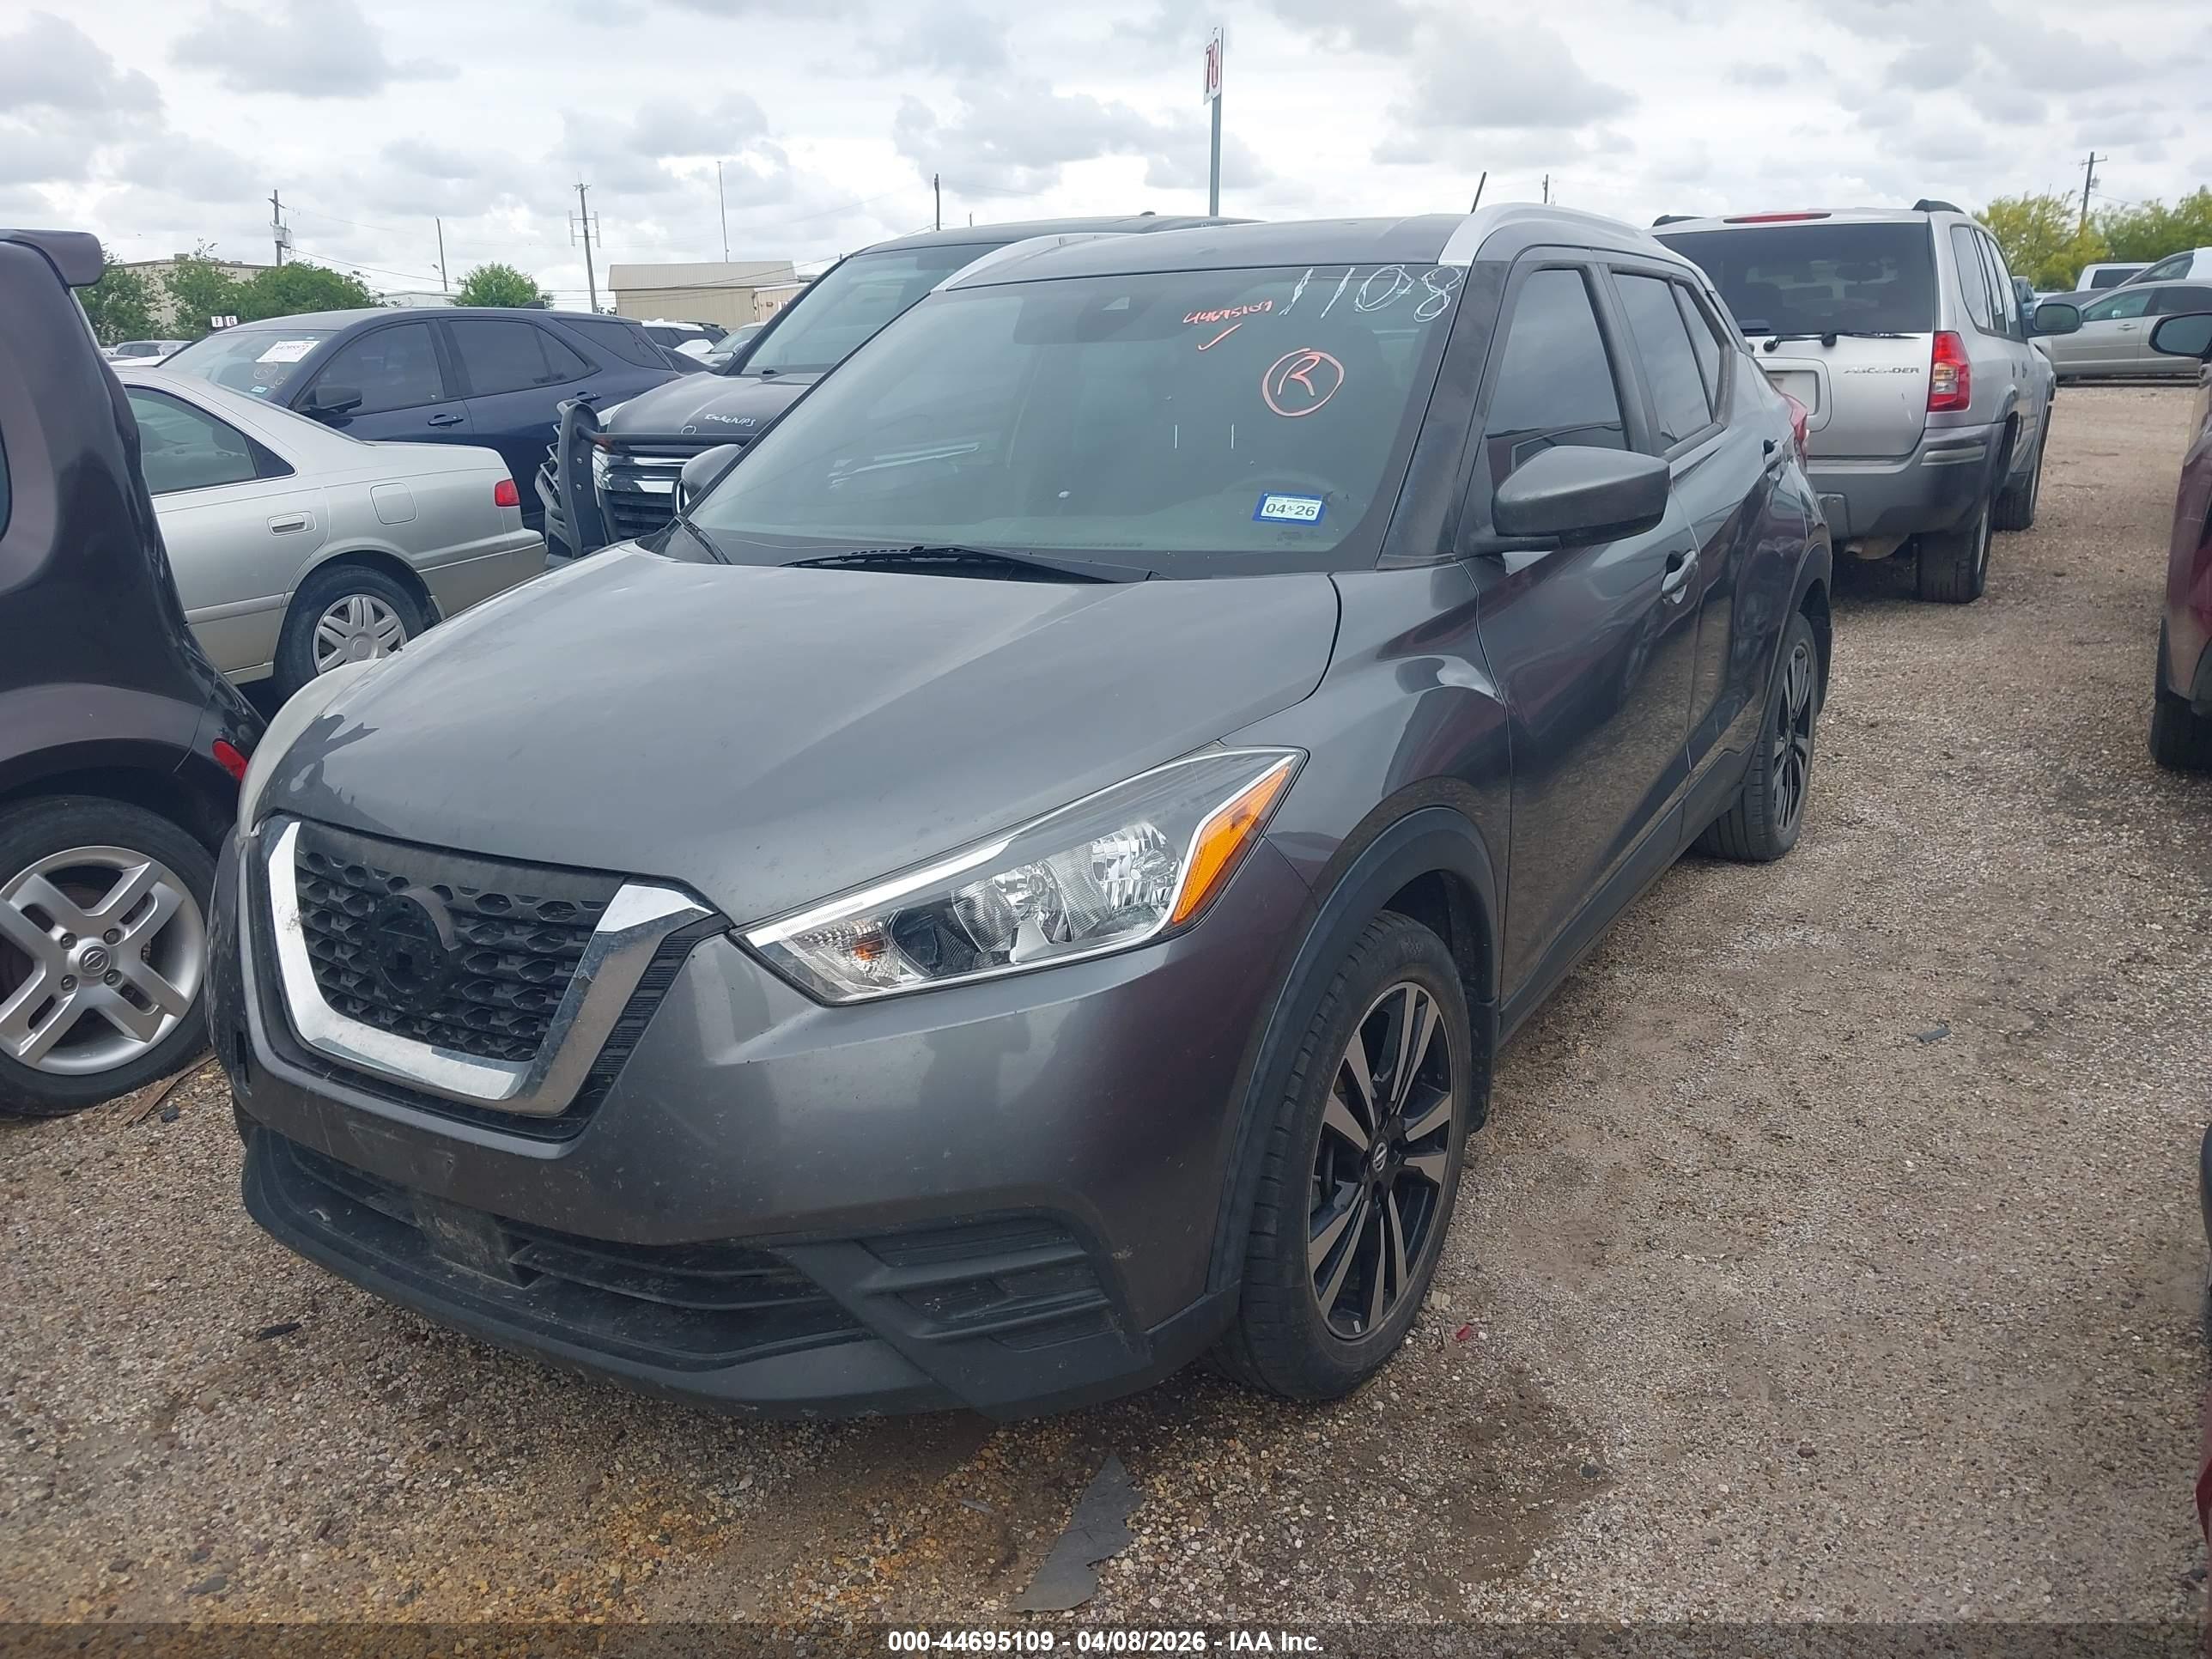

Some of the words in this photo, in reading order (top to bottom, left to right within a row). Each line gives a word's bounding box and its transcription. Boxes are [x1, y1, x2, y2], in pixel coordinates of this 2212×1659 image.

[1279, 264, 1463, 322] 1108
[1277, 354, 1322, 397] R
[1266, 502, 1286, 514] 04
[1294, 505, 1316, 517] 26
